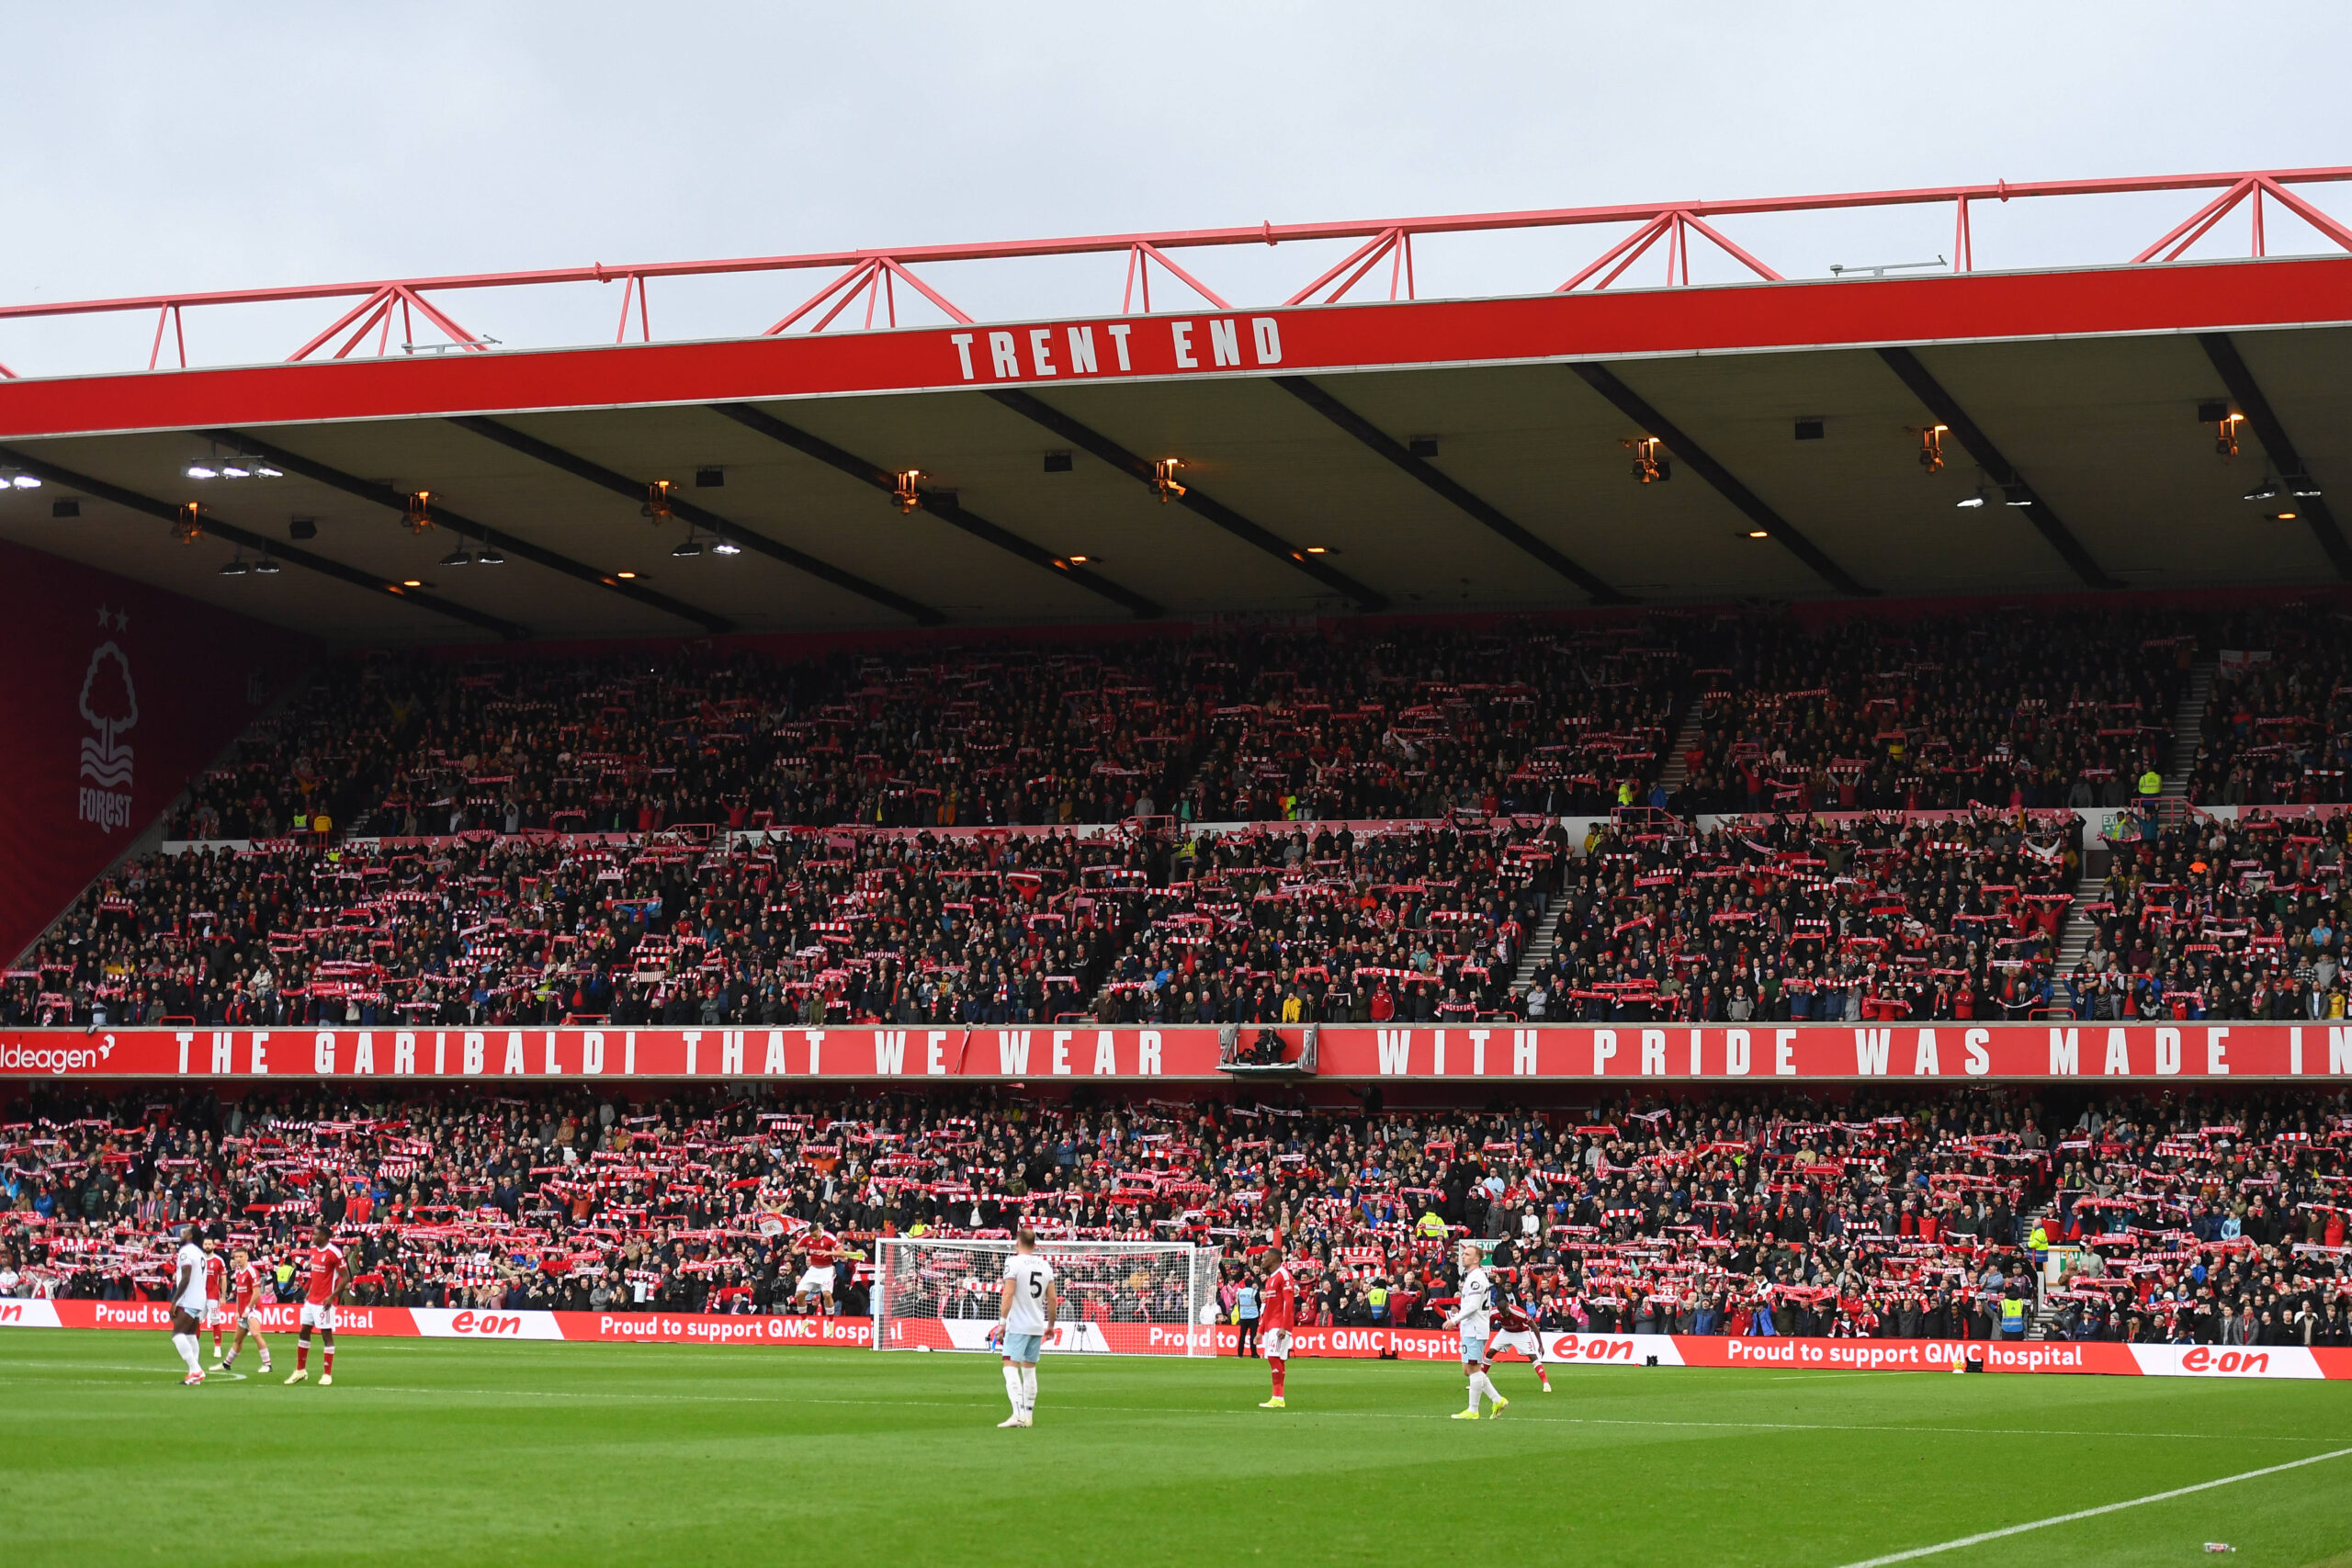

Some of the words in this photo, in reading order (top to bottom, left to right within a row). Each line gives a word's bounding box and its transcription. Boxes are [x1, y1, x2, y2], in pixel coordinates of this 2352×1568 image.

[951, 324, 1131, 380] TRENT
[1171, 317, 1283, 369] END
[0, 1043, 96, 1074] Ideagen
[175, 1032, 269, 1074] THE
[315, 1032, 636, 1075] GARIBALDI
[683, 1031, 826, 1075] THAT
[875, 1031, 947, 1075] WE
[999, 1031, 1162, 1075] WEAR
[1377, 1029, 1537, 1075] WITH
[1594, 1029, 1796, 1075] PRIDE
[1855, 1028, 1990, 1075] WAS
[2050, 1028, 2230, 1075] MADE
[2290, 1028, 2352, 1075] IN
[1029, 1271, 1043, 1299] 5
[96, 1303, 149, 1324] Proud
[153, 1306, 171, 1324] to
[319, 1311, 325, 1322] 9
[600, 1316, 657, 1336] Proud
[662, 1318, 683, 1336] to
[687, 1320, 763, 1344] support
[768, 1319, 817, 1339] QMC
[1216, 1331, 1238, 1348] to
[1327, 1331, 1384, 1351] QMC
[1728, 1339, 1794, 1361] Proud
[1801, 1343, 1824, 1361] to
[1830, 1344, 1918, 1368] support
[1925, 1343, 1982, 1364] QMC
[1989, 1345, 2083, 1367] hospital
